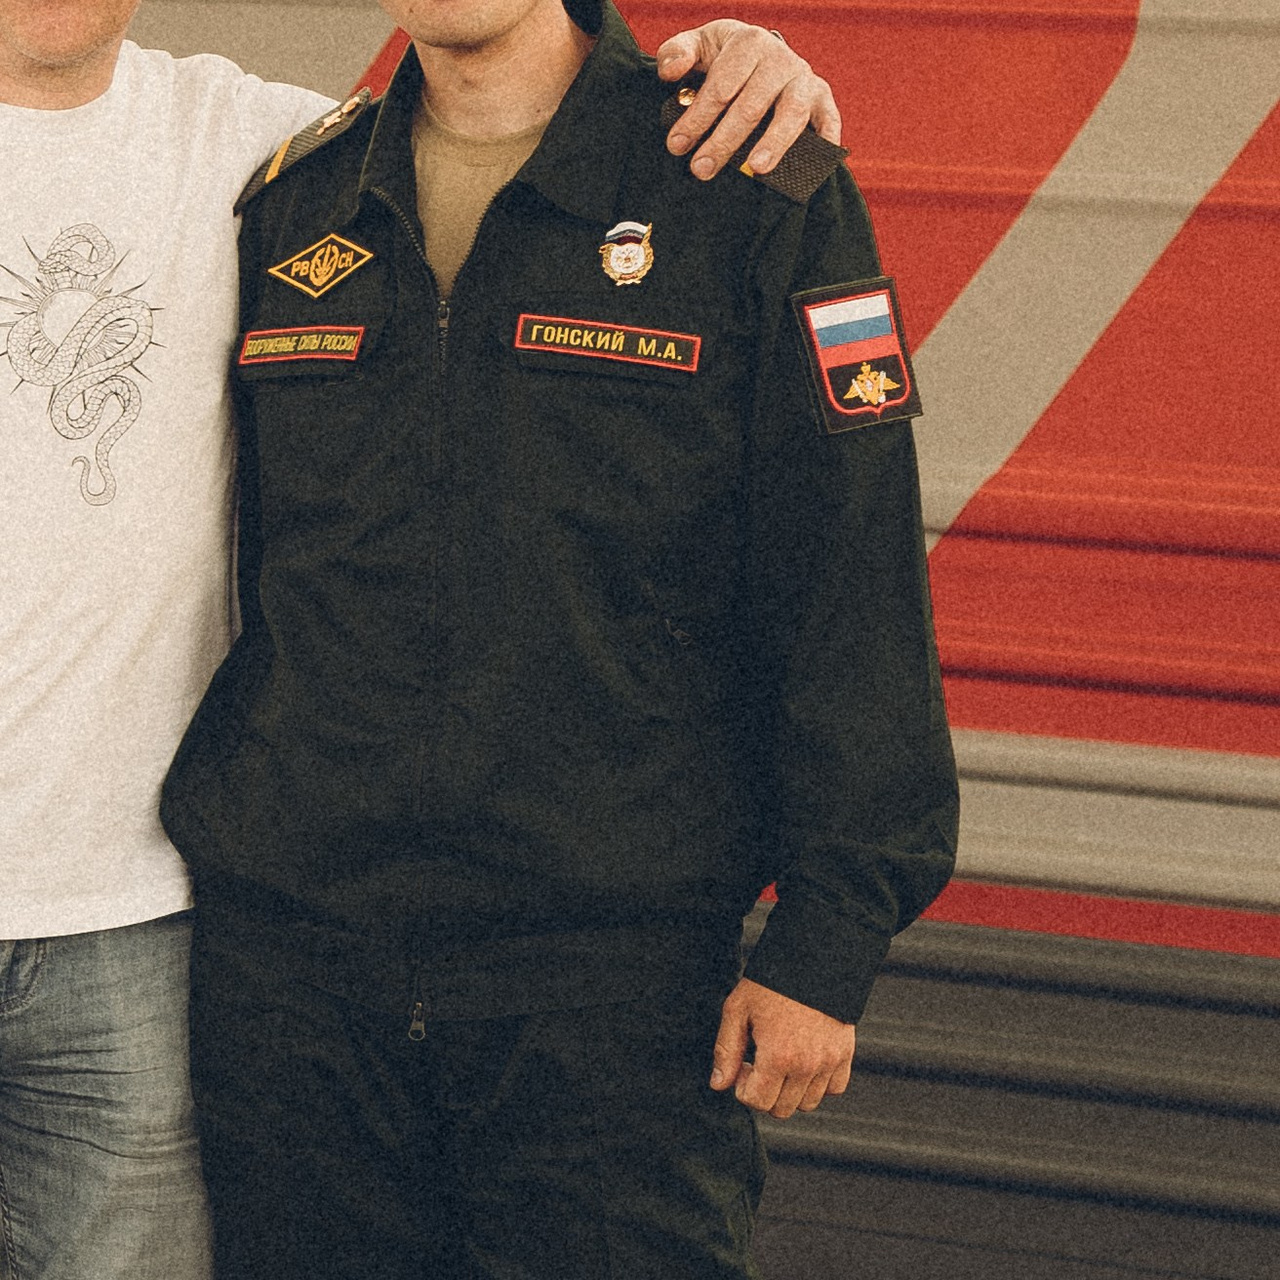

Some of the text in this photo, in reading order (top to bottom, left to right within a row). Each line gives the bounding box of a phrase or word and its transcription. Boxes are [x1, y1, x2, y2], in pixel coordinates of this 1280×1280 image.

[321, 335, 358, 350] РОССИИ
[530, 324, 683, 361] ГОНСКИЙ М.А.
